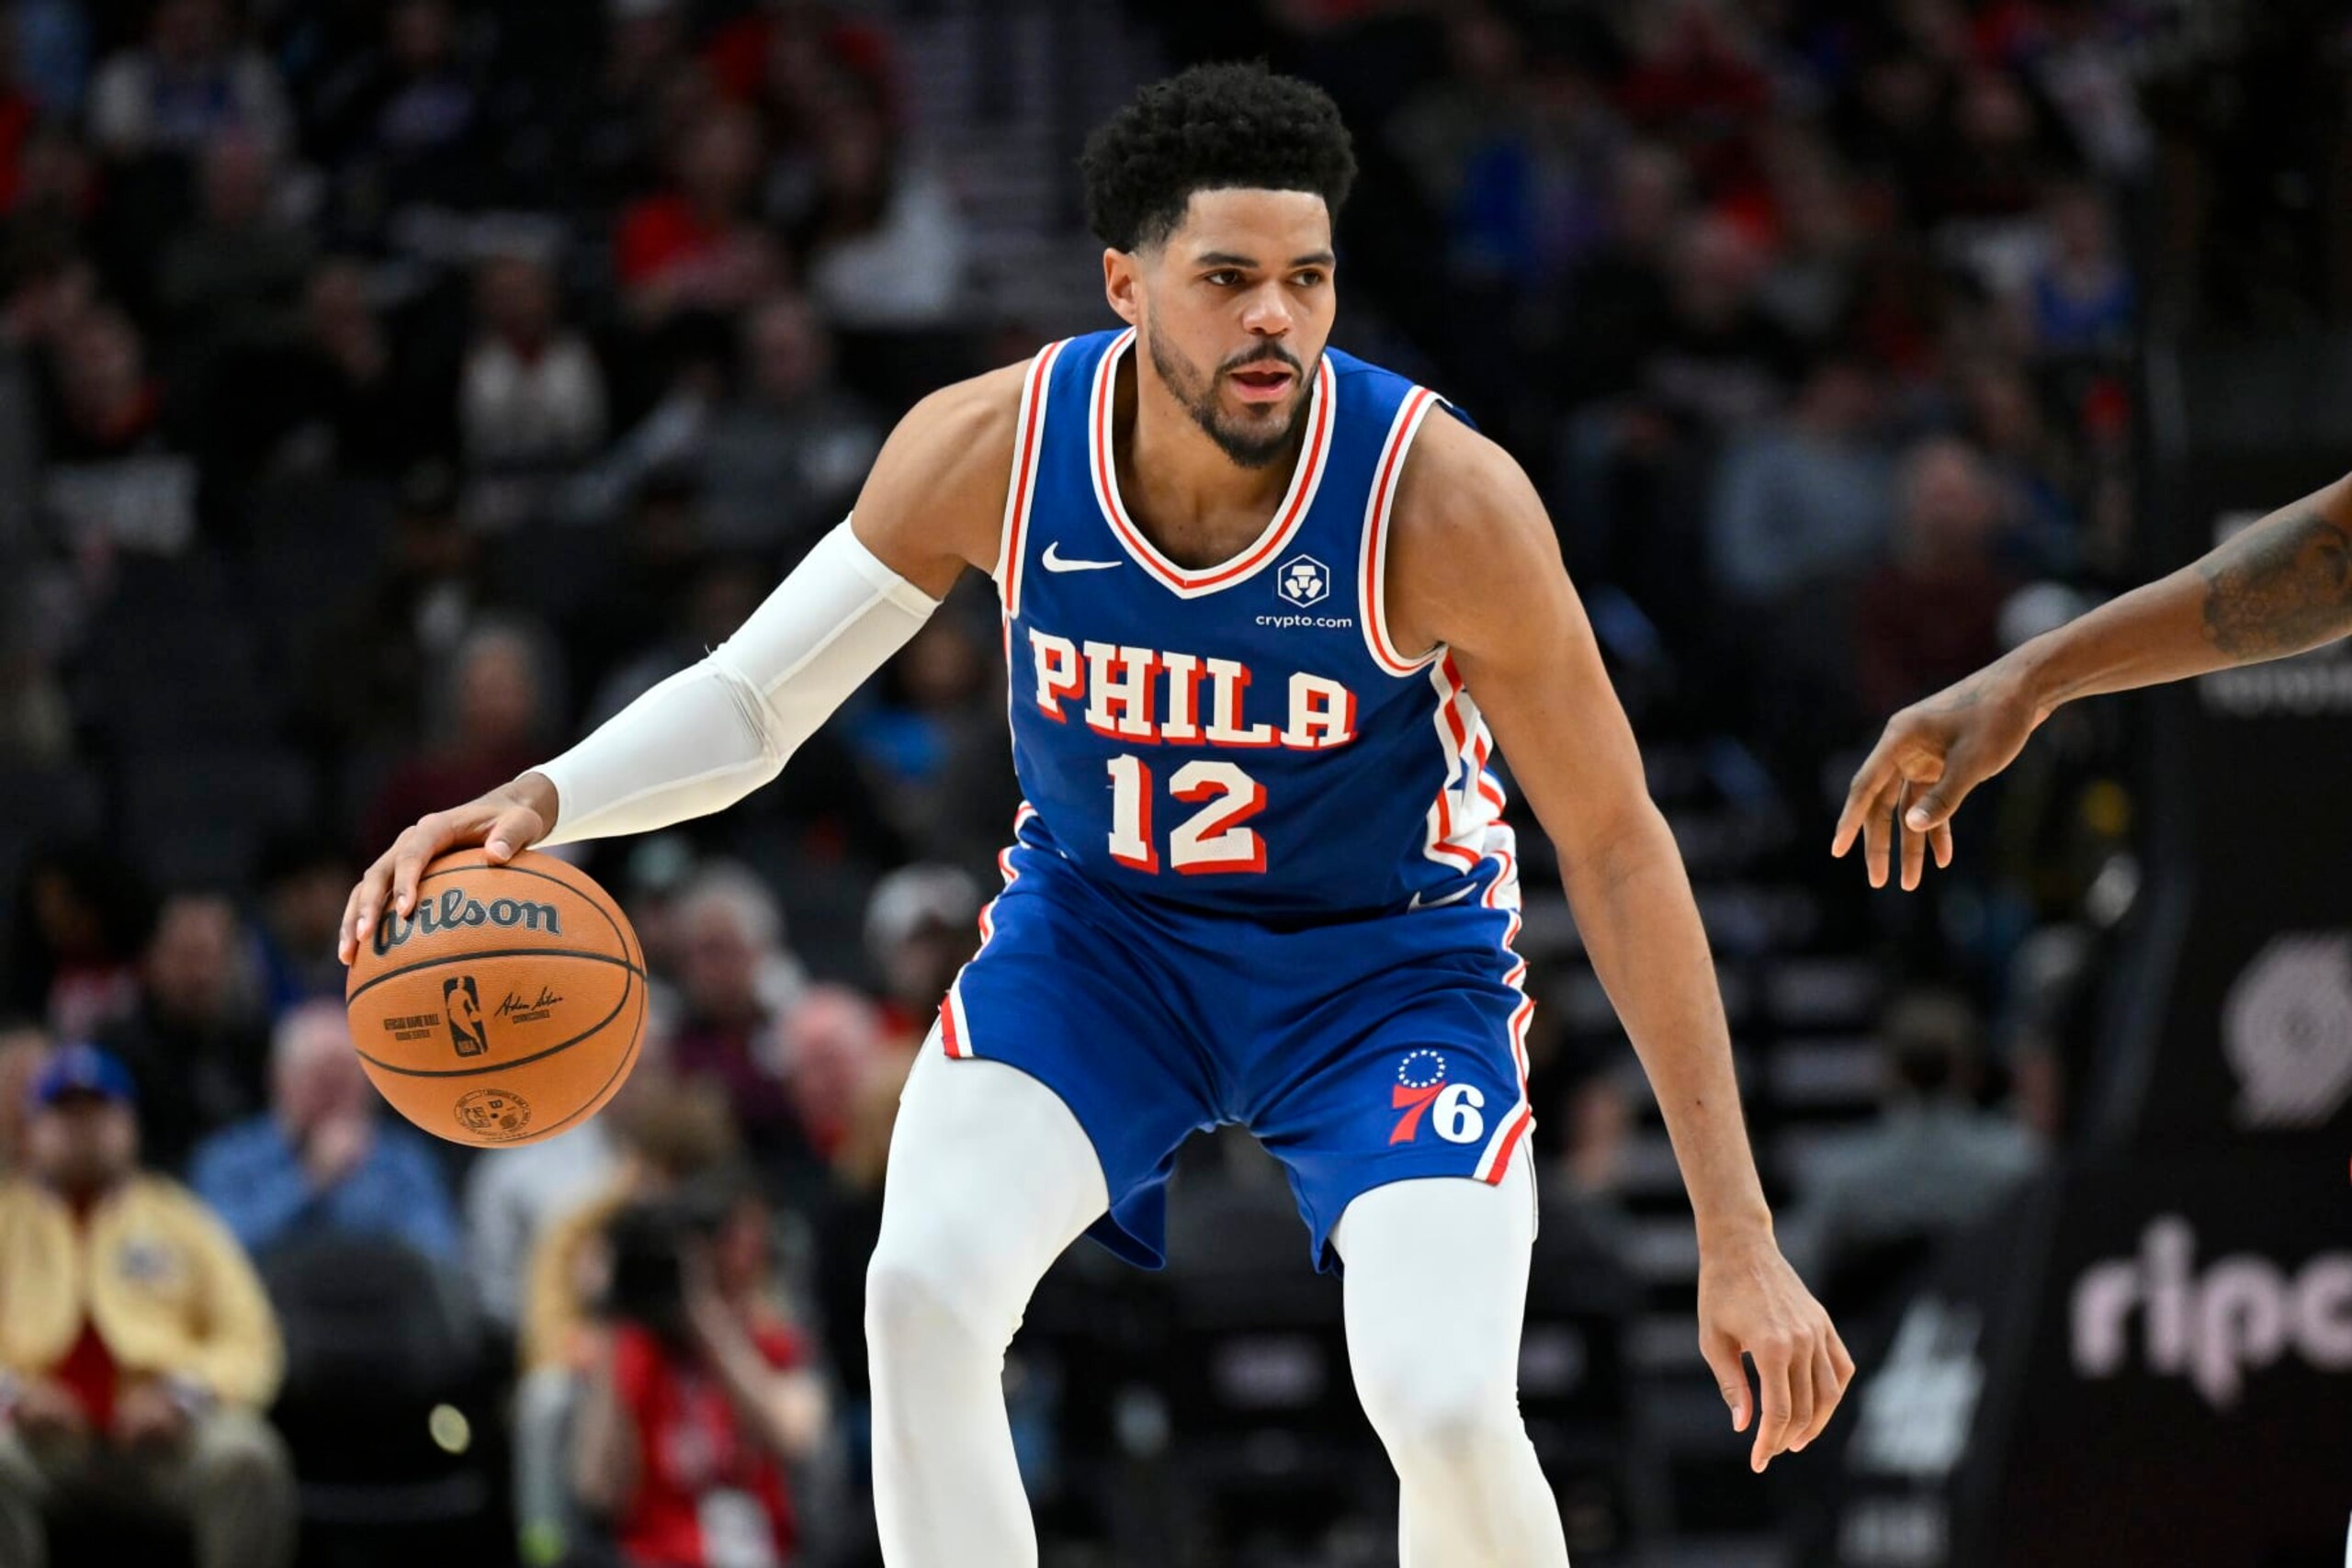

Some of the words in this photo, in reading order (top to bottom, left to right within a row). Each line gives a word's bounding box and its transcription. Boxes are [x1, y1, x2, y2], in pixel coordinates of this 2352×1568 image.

[1255, 614, 1352, 628] crypto.com
[1029, 626, 1358, 750] PHILA
[1107, 753, 1267, 874] 12
[372, 887, 562, 956] Wilson
[1389, 1079, 1485, 1146] 76
